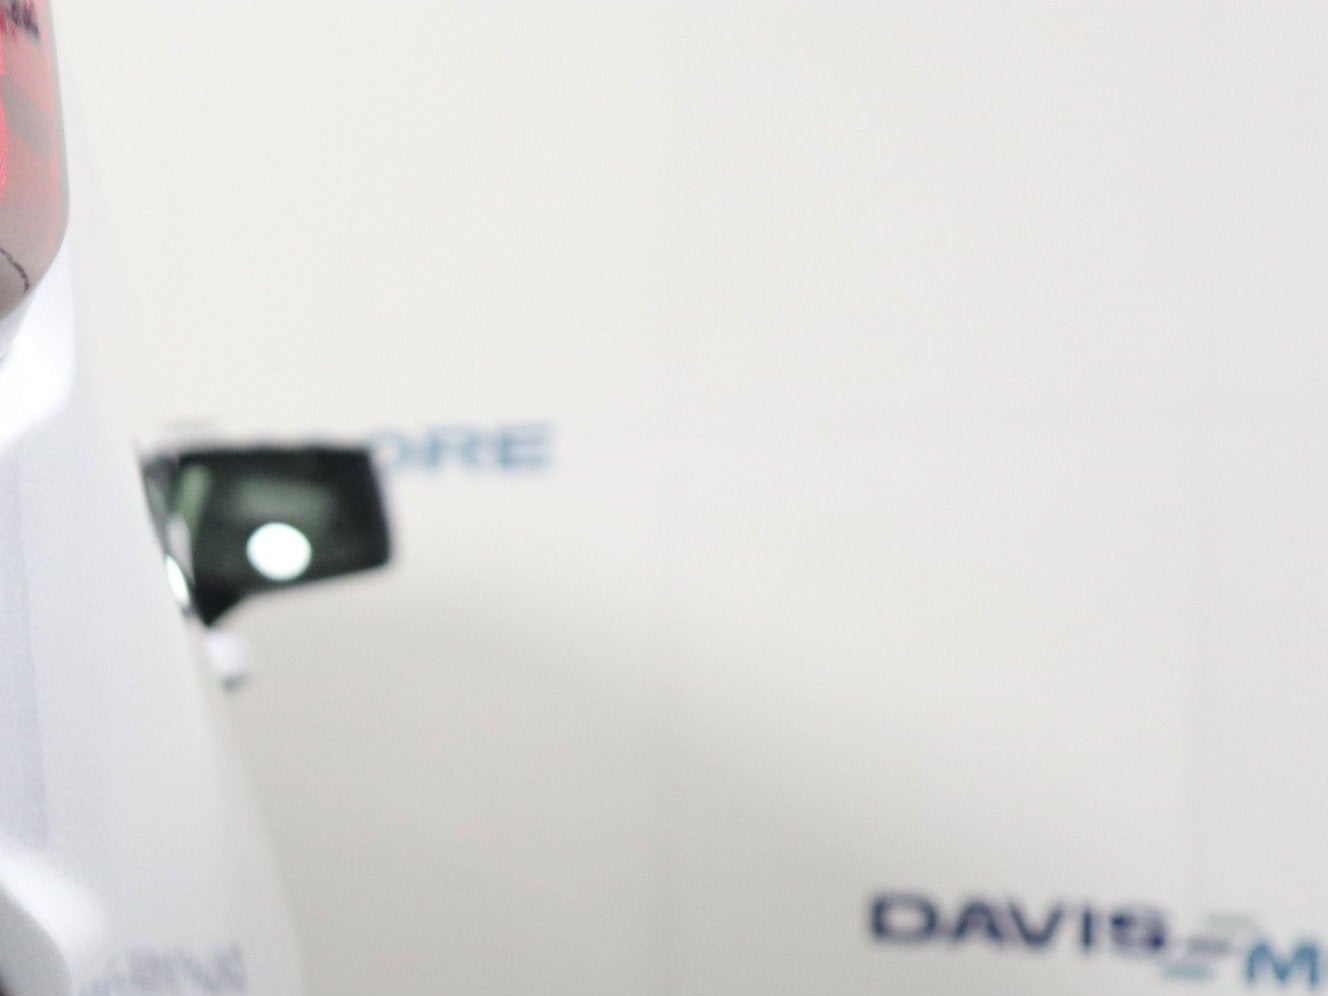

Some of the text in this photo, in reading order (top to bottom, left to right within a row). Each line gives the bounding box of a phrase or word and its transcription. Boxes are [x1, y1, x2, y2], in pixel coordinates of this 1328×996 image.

[366, 418, 555, 472] ORE
[868, 894, 1328, 992] DAVIS M
